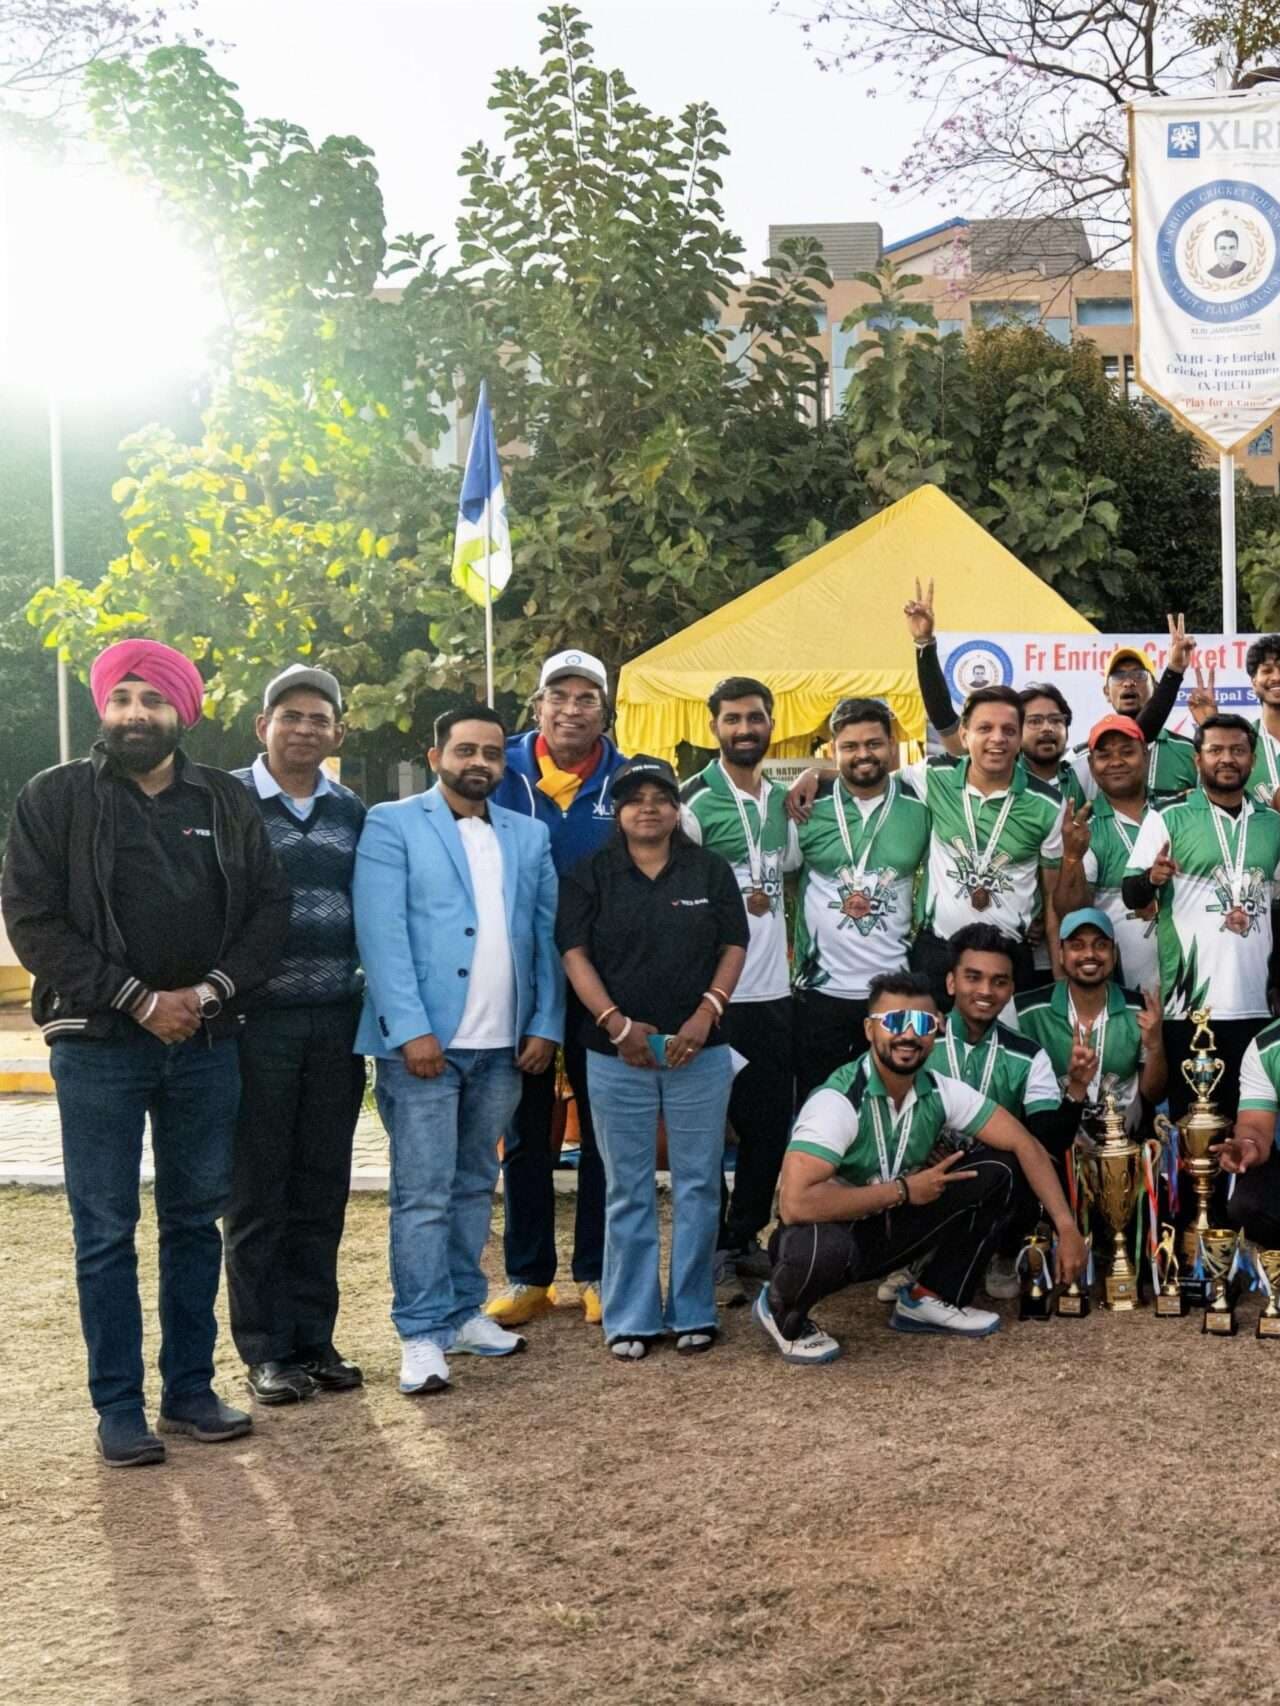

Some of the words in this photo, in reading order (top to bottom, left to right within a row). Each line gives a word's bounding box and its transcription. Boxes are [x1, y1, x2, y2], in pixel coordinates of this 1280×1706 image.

[1232, 351, 1276, 363] Enright
[1166, 364, 1208, 378] Cricket
[1025, 643, 1048, 672] Fr
